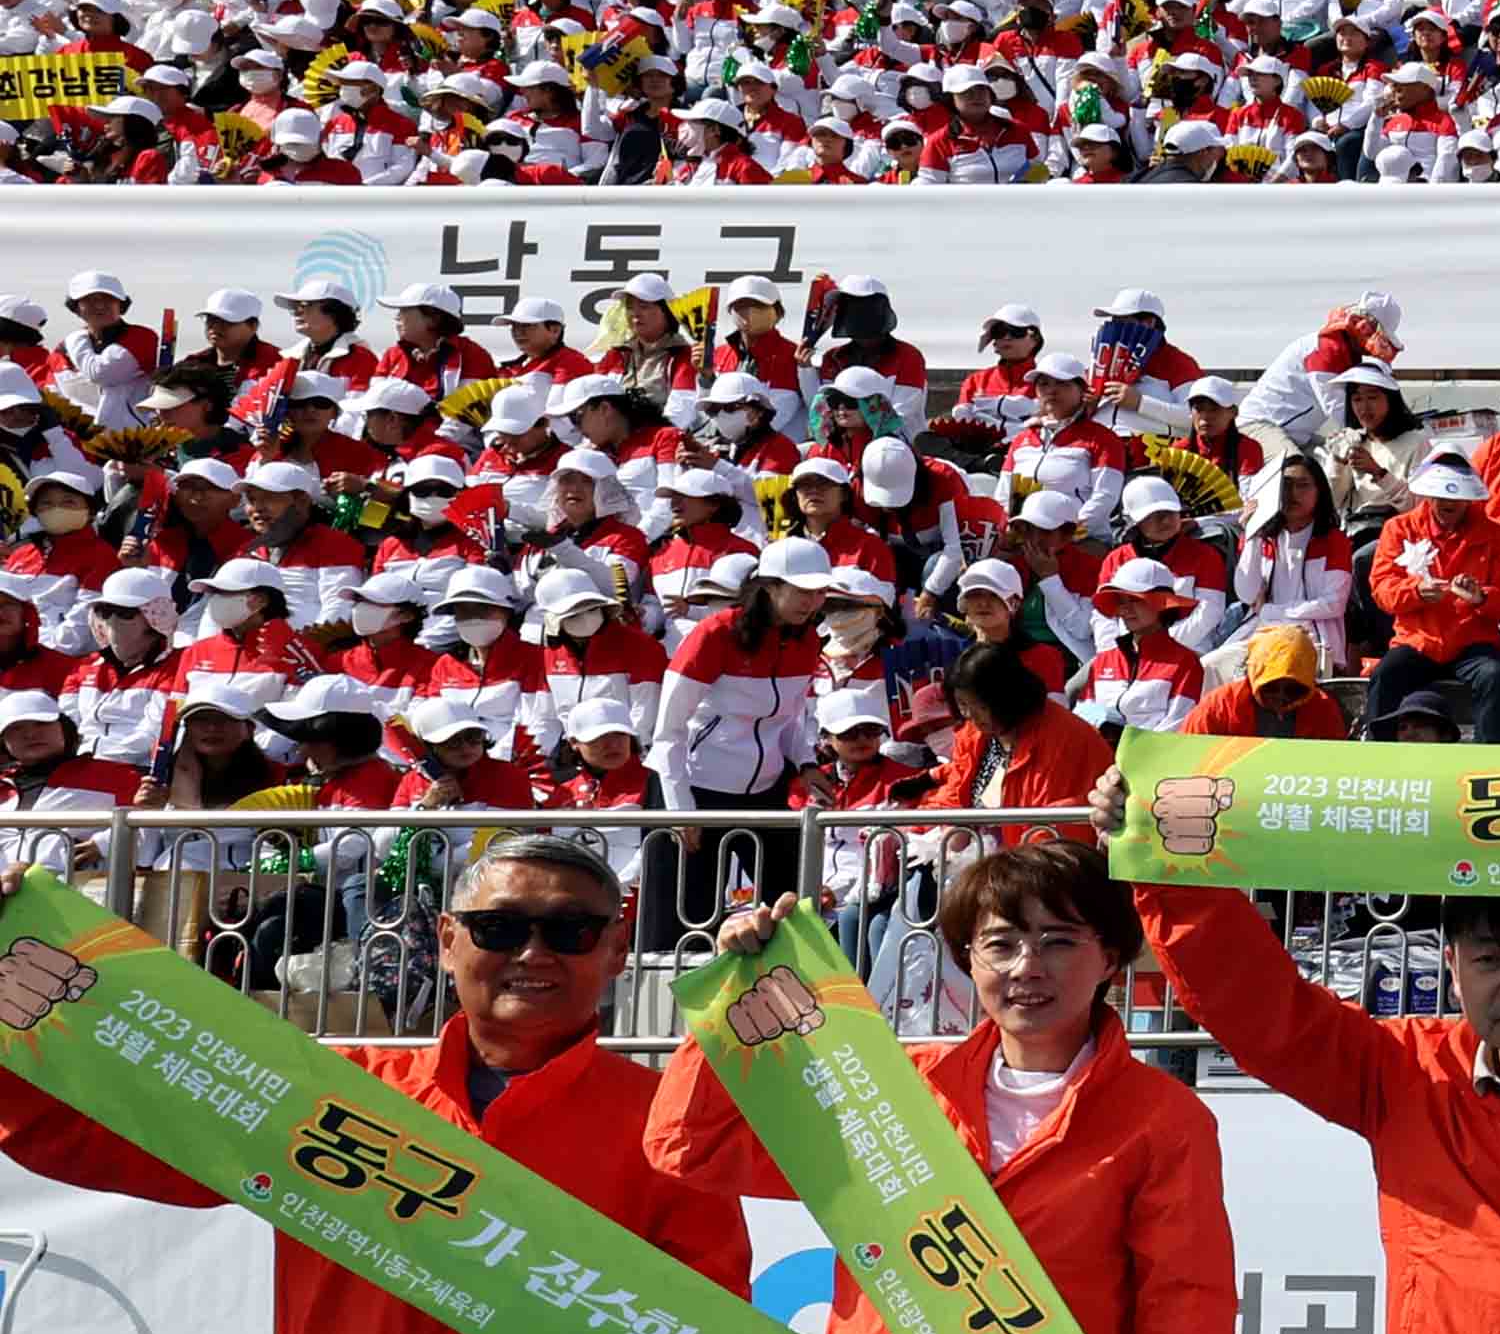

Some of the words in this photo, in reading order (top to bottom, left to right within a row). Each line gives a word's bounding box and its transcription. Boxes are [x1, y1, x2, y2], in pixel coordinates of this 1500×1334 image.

[439, 219, 803, 326] 남동구
[1256, 802, 1313, 834] 생활
[1320, 805, 1431, 838] 체육대회
[1263, 774, 1329, 799] 2023
[1335, 776, 1432, 807] 인천시민
[92, 1011, 156, 1066] 생활
[160, 1052, 272, 1134] 체육대회
[119, 989, 192, 1041] 2023
[195, 1032, 293, 1106] 인천시민
[799, 1055, 838, 1112] 생활
[836, 1104, 909, 1207] 체육대회
[831, 1041, 879, 1103] 2023
[875, 1099, 936, 1188] 인천시민
[290, 1102, 478, 1220] 동구
[447, 1208, 528, 1270] 가
[279, 1188, 498, 1329] 인천광역시동구체육회
